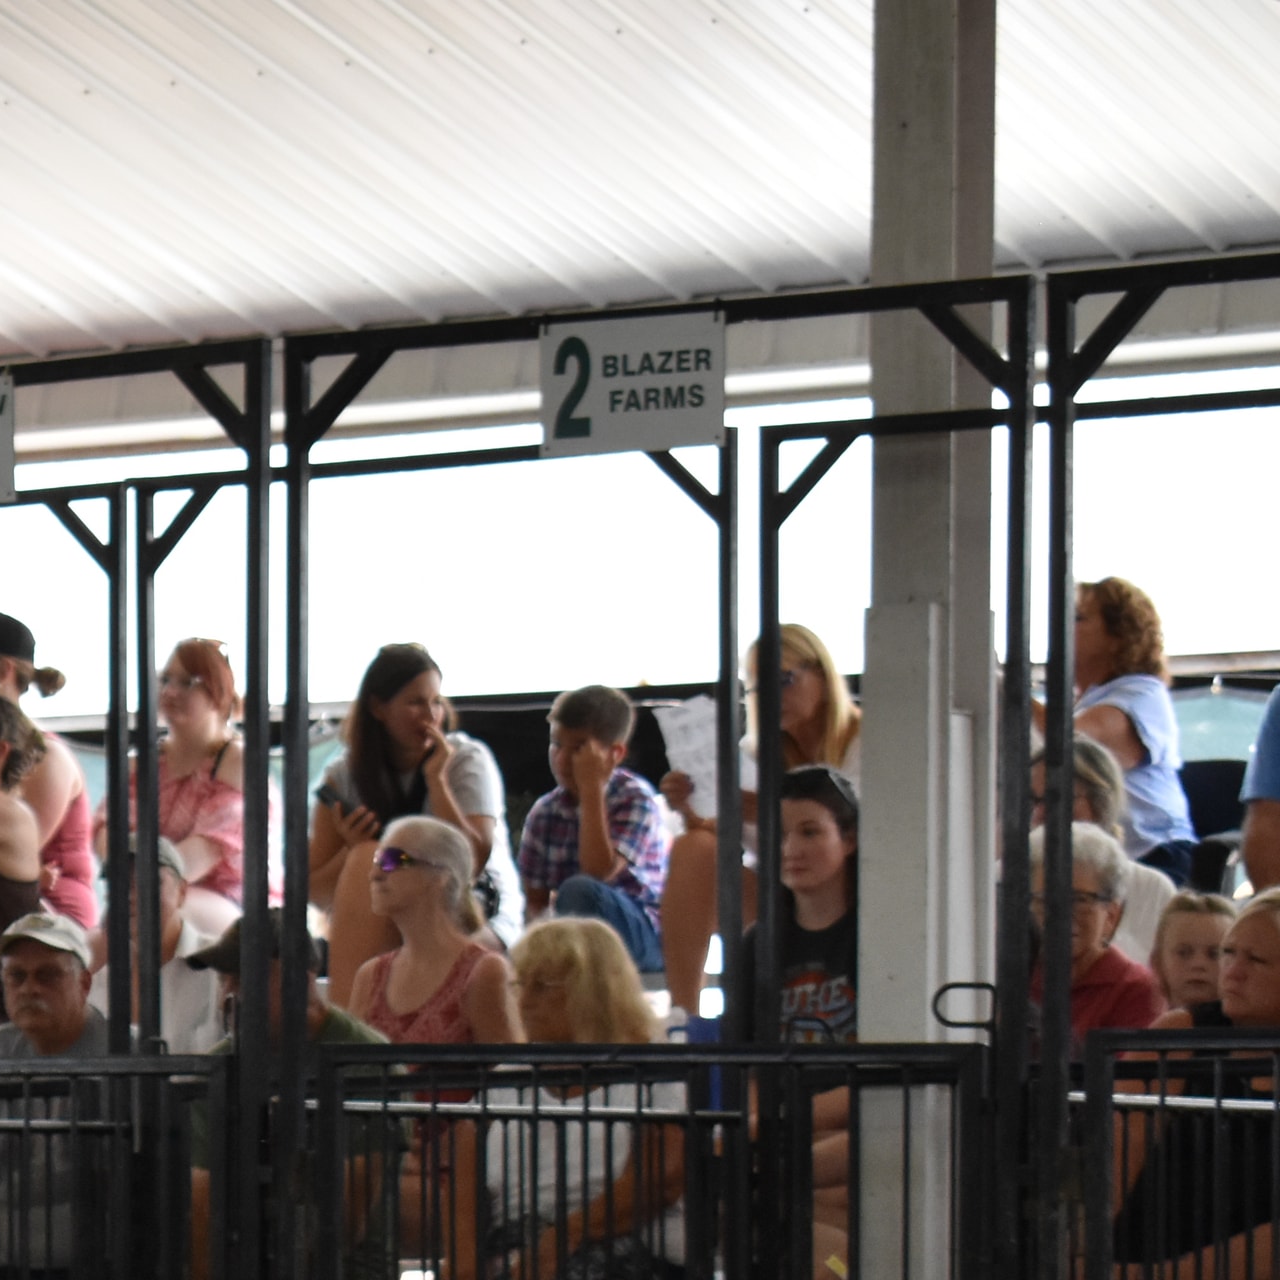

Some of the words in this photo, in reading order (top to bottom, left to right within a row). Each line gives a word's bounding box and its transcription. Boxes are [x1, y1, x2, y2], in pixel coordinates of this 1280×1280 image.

[601, 348, 712, 378] BLAZER
[553, 336, 591, 439] 2
[609, 385, 704, 413] FARMS
